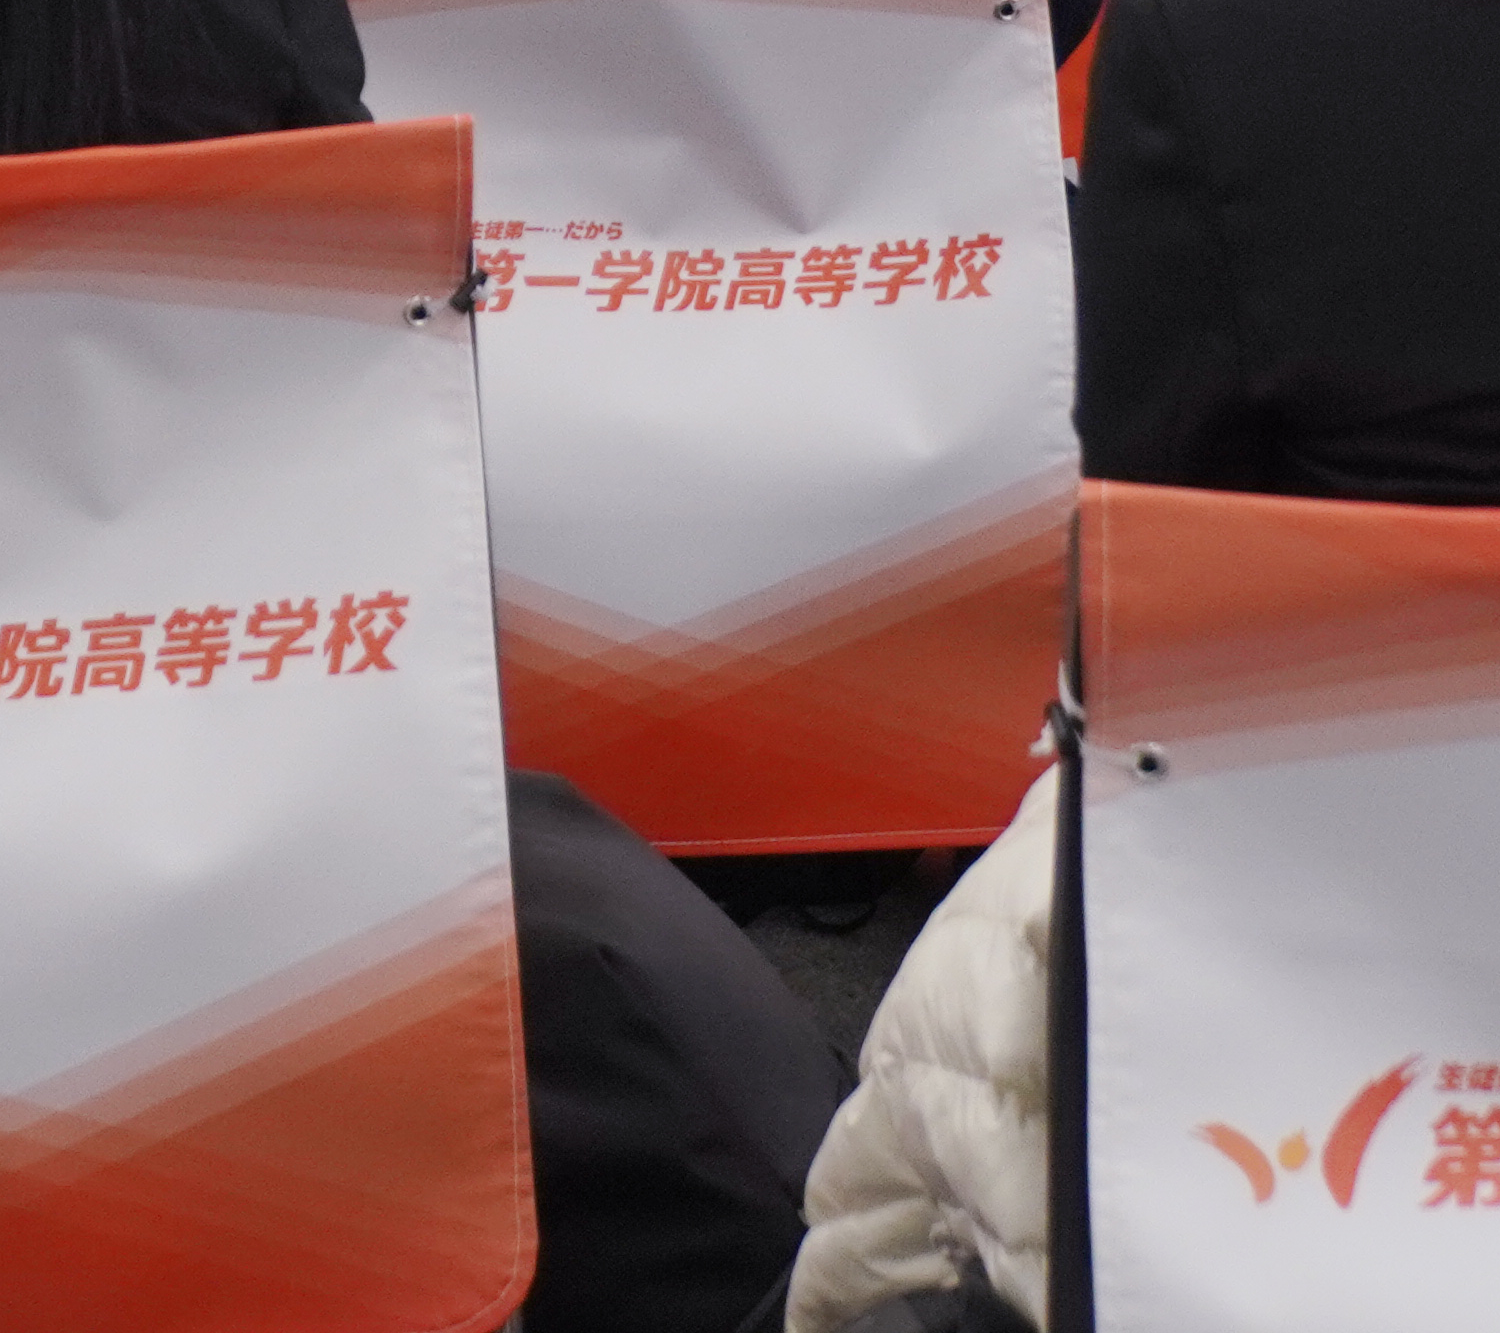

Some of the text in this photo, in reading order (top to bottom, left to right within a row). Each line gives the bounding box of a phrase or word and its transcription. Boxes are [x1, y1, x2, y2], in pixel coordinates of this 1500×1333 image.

[473, 232, 1003, 314] 第一学院高等学校
